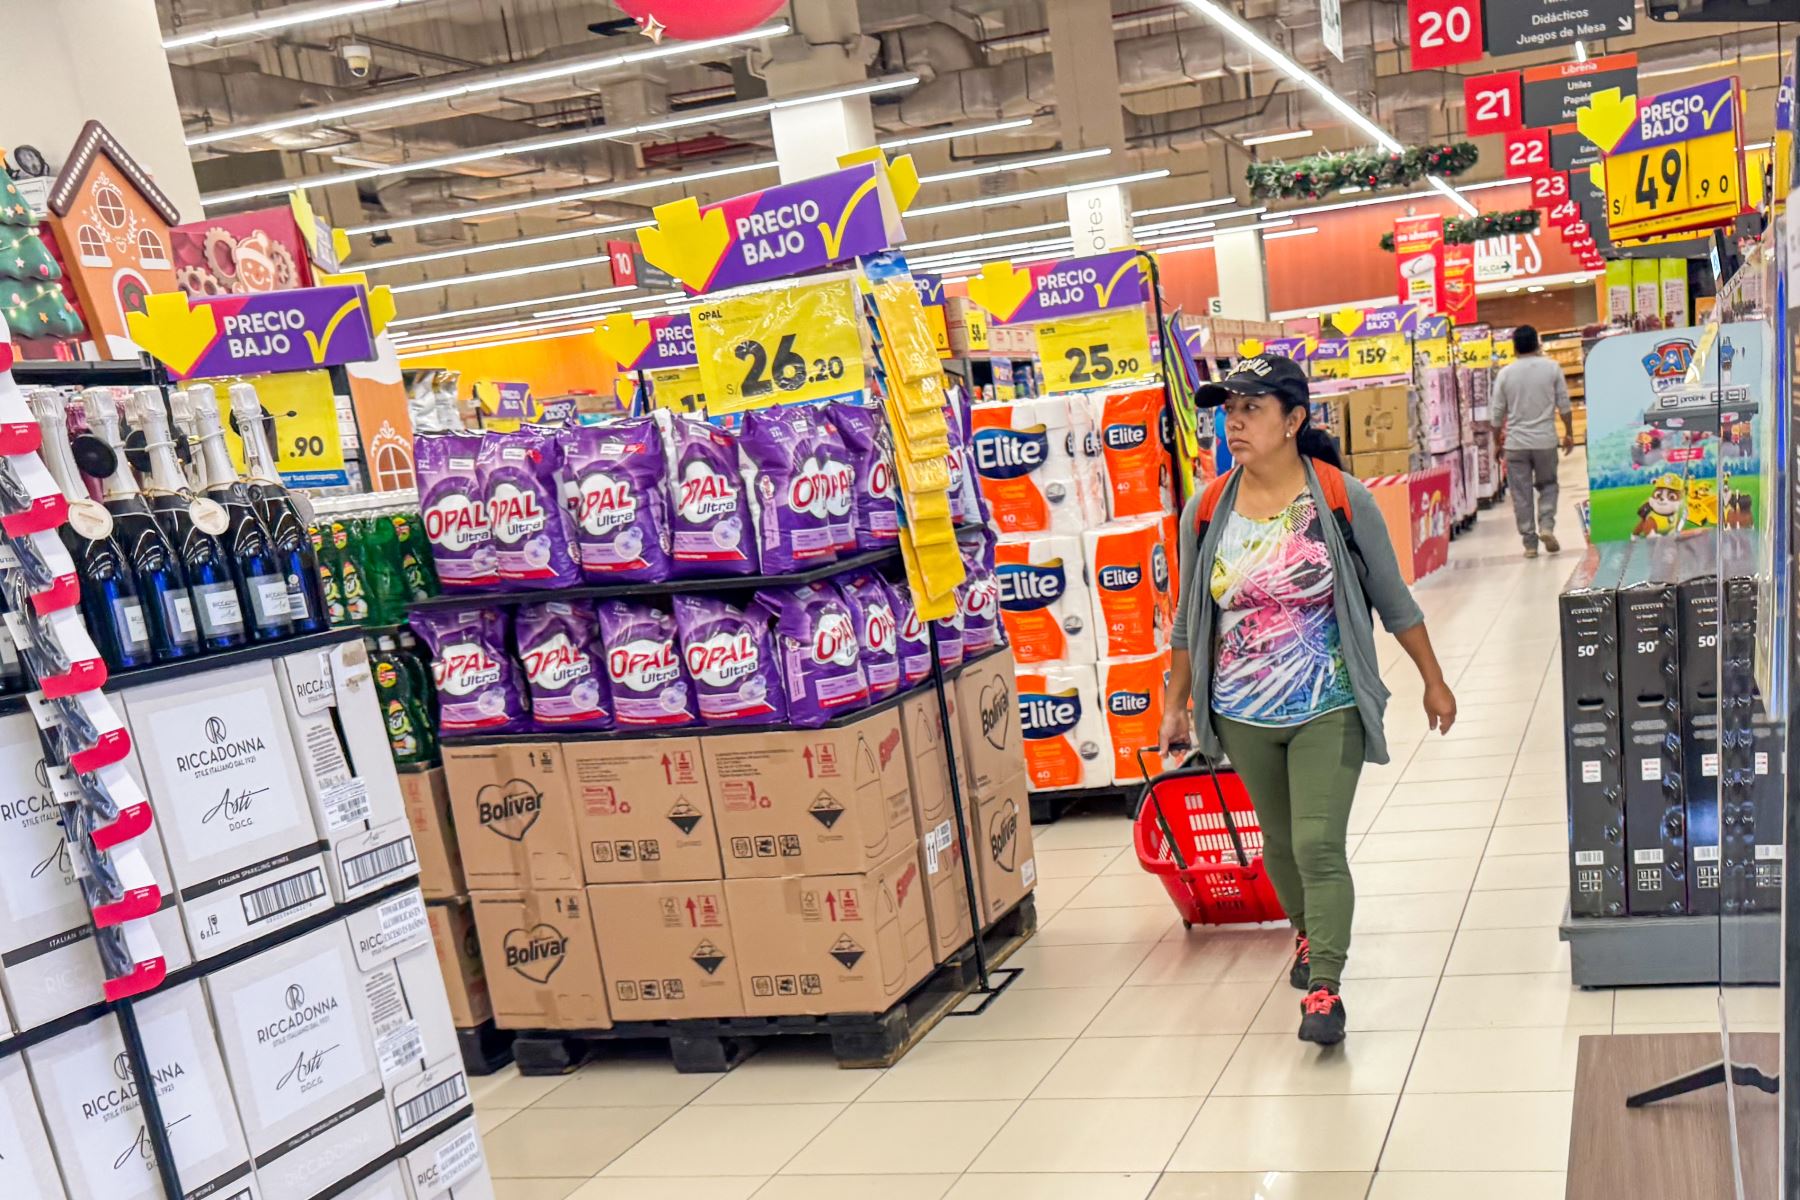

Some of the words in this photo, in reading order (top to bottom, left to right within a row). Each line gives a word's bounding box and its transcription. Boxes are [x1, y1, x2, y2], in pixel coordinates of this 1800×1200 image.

[1418, 6, 1471, 49] 20
[1531, 8, 1589, 26] Didácticos
[1516, 30, 1558, 46] Juegos
[1559, 27, 1574, 38] de
[1576, 22, 1606, 35] Mesa
[1475, 88, 1511, 121] 21
[1640, 95, 1704, 124] PRECIO
[1641, 115, 1689, 140] BAJO
[1509, 140, 1544, 166] 22
[1535, 176, 1566, 197] 23
[735, 199, 820, 241] PRECIO
[742, 231, 806, 266] BAJO
[615, 253, 632, 275] 10
[1037, 268, 1097, 291] PRECIO
[1039, 287, 1085, 307] BAJO
[223, 308, 306, 336] PRECIO
[698, 310, 723, 321] OPAL
[1366, 311, 1397, 322] PRECIO
[1366, 321, 1391, 331] BAJO
[228, 333, 292, 358] BAJO
[1356, 348, 1387, 365] 159
[289, 435, 324, 458] .90
[1108, 427, 1145, 446] Elite
[976, 434, 1042, 470] Elite
[597, 511, 634, 528] Ultra
[696, 501, 736, 516] Ultra
[426, 502, 487, 540] OPAL
[507, 519, 544, 537] Ultra
[456, 528, 490, 545] Ultra
[998, 571, 1060, 602] Elite
[1102, 570, 1139, 587] Elite
[610, 644, 679, 678] OPAL
[687, 636, 756, 677] OPAL
[460, 672, 500, 688] Ultra
[553, 665, 590, 683] Ultra
[642, 668, 680, 684] Ultra
[719, 662, 757, 680] Ultra
[1112, 696, 1148, 711] Elite
[177, 737, 266, 772] RICCADONNA
[201, 788, 270, 824] Asti
[217, 872, 241, 886] ITALIAN
[49, 932, 77, 948] ITALIAN
[256, 996, 338, 1045] RICCADONNA
[275, 1044, 340, 1090] Asti
[82, 1062, 185, 1119] RICCADNNA
